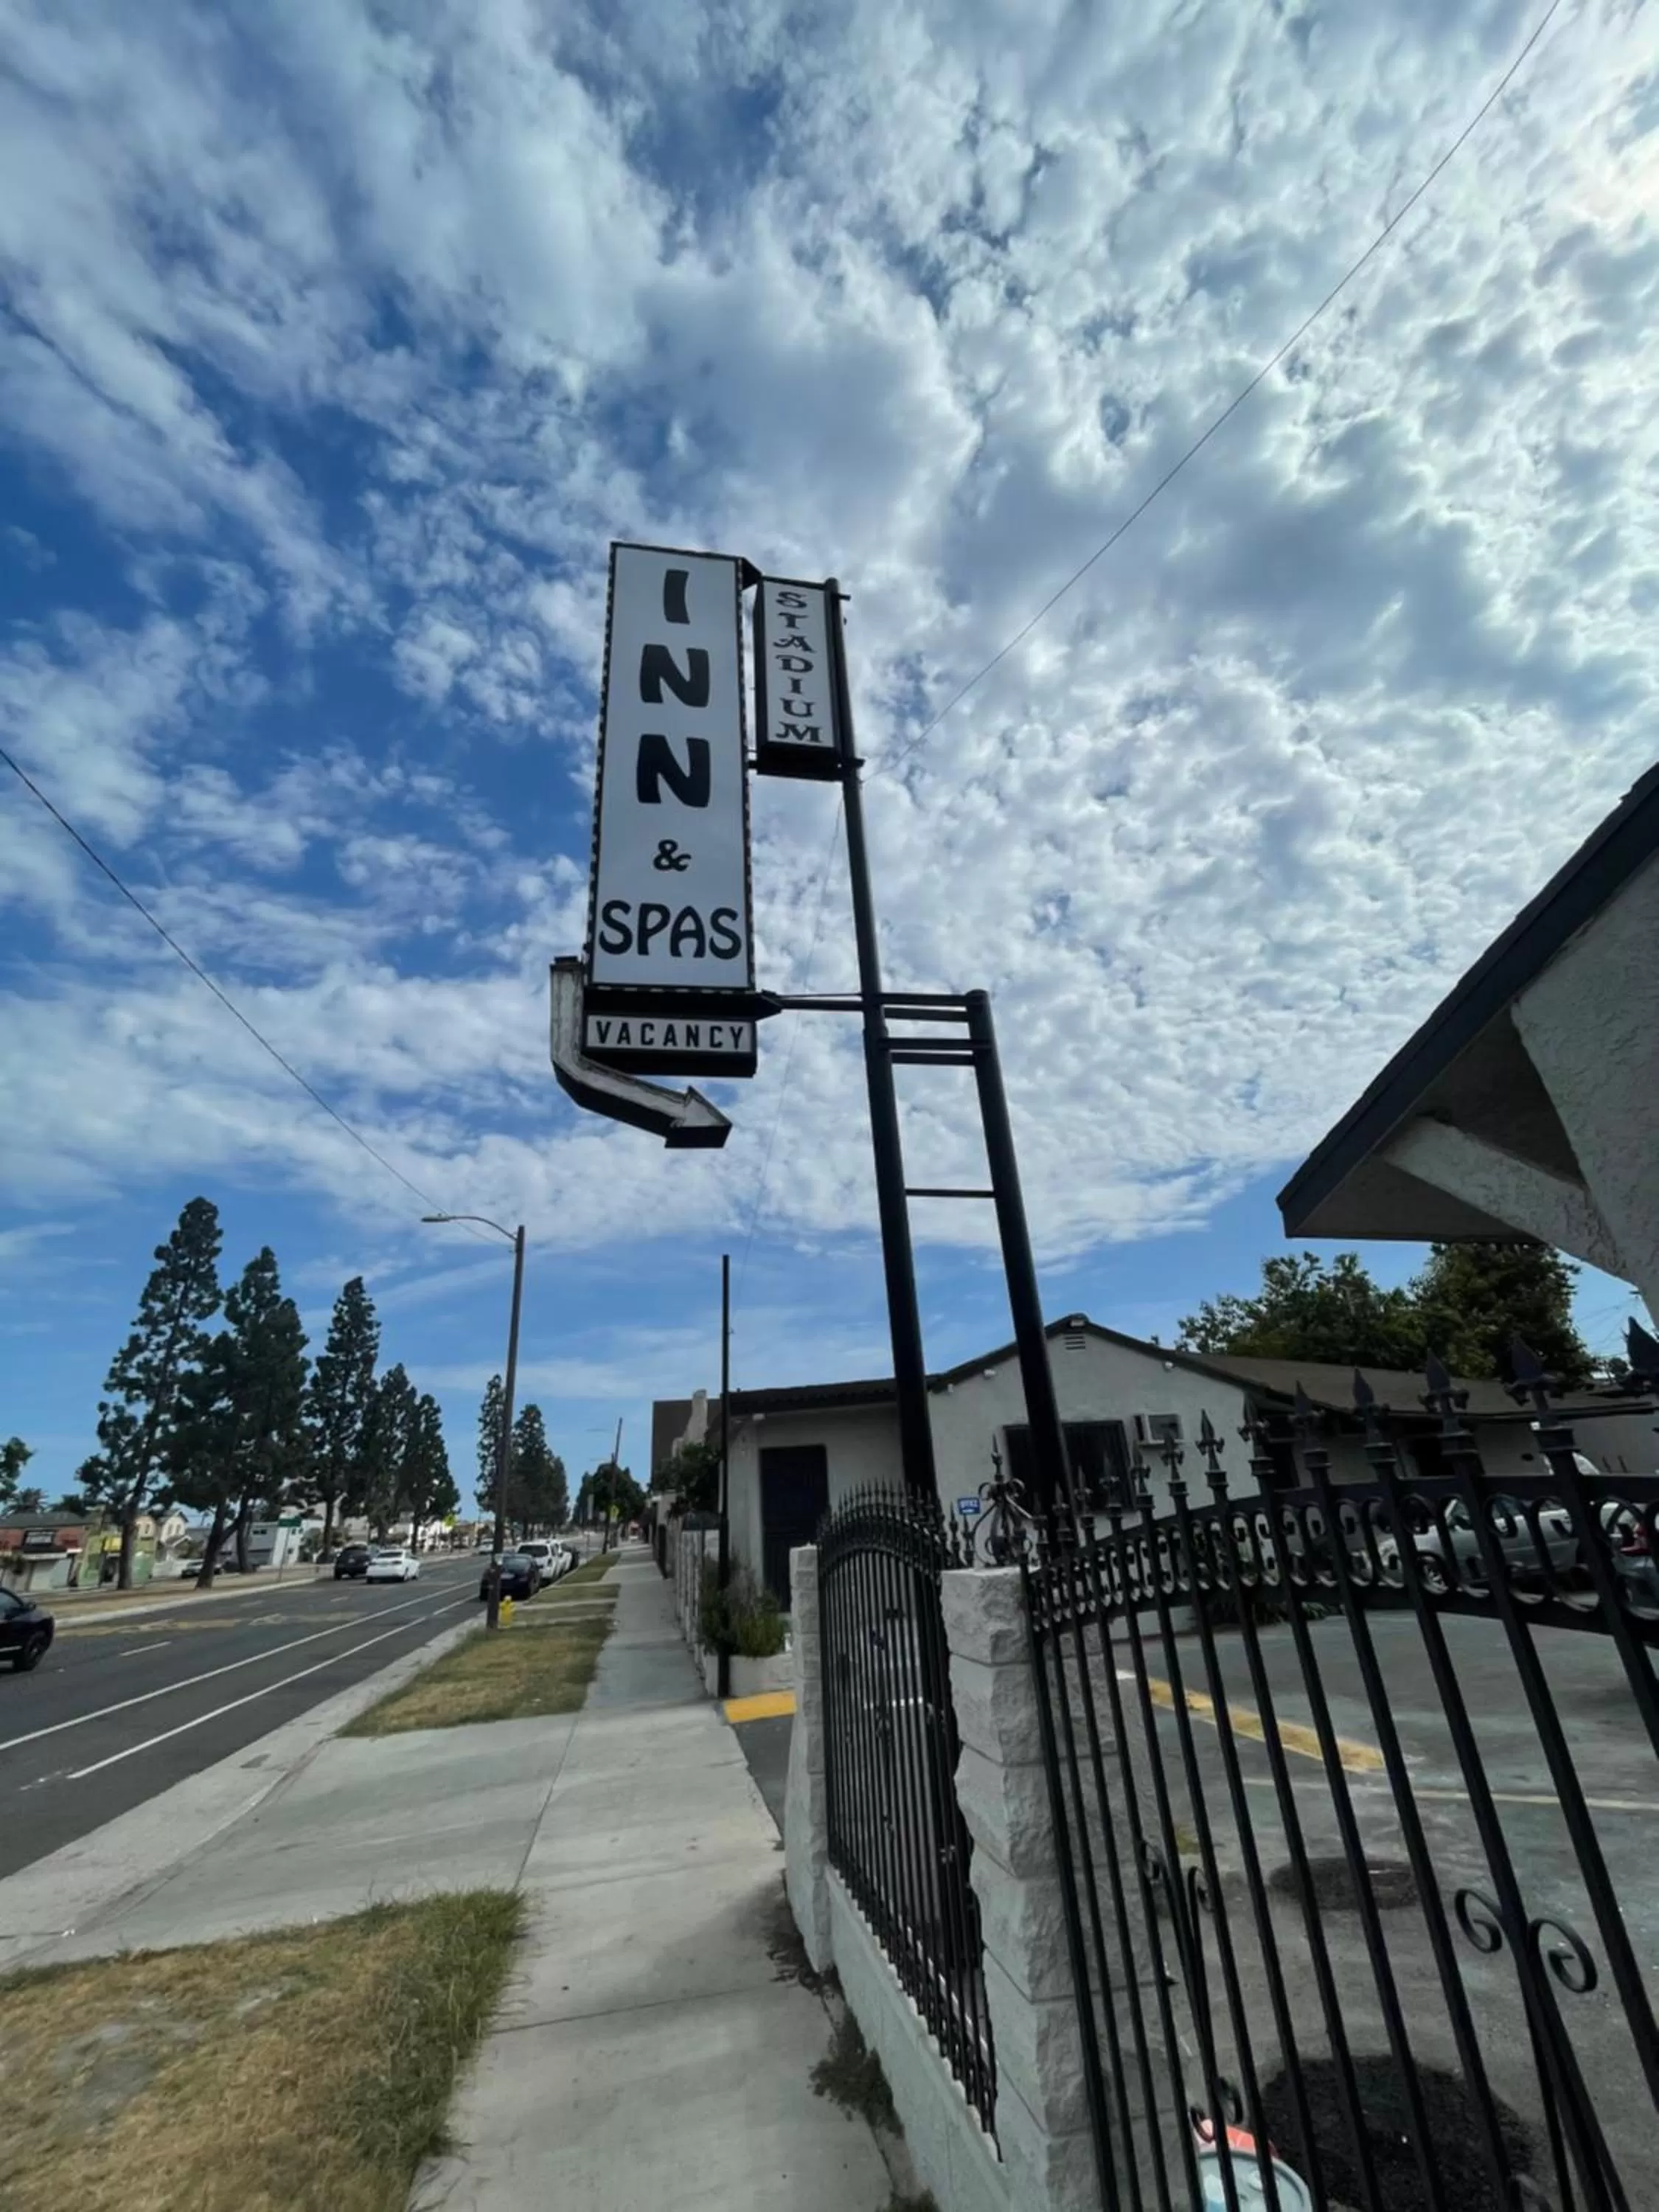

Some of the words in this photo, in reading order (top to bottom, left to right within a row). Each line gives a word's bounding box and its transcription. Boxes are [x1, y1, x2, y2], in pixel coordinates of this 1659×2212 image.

[636, 568, 711, 808] INN
[773, 591, 822, 742] STADIUM
[653, 839, 692, 872] &
[599, 900, 742, 960] SPAS
[596, 1020, 744, 1049] VACANCY
